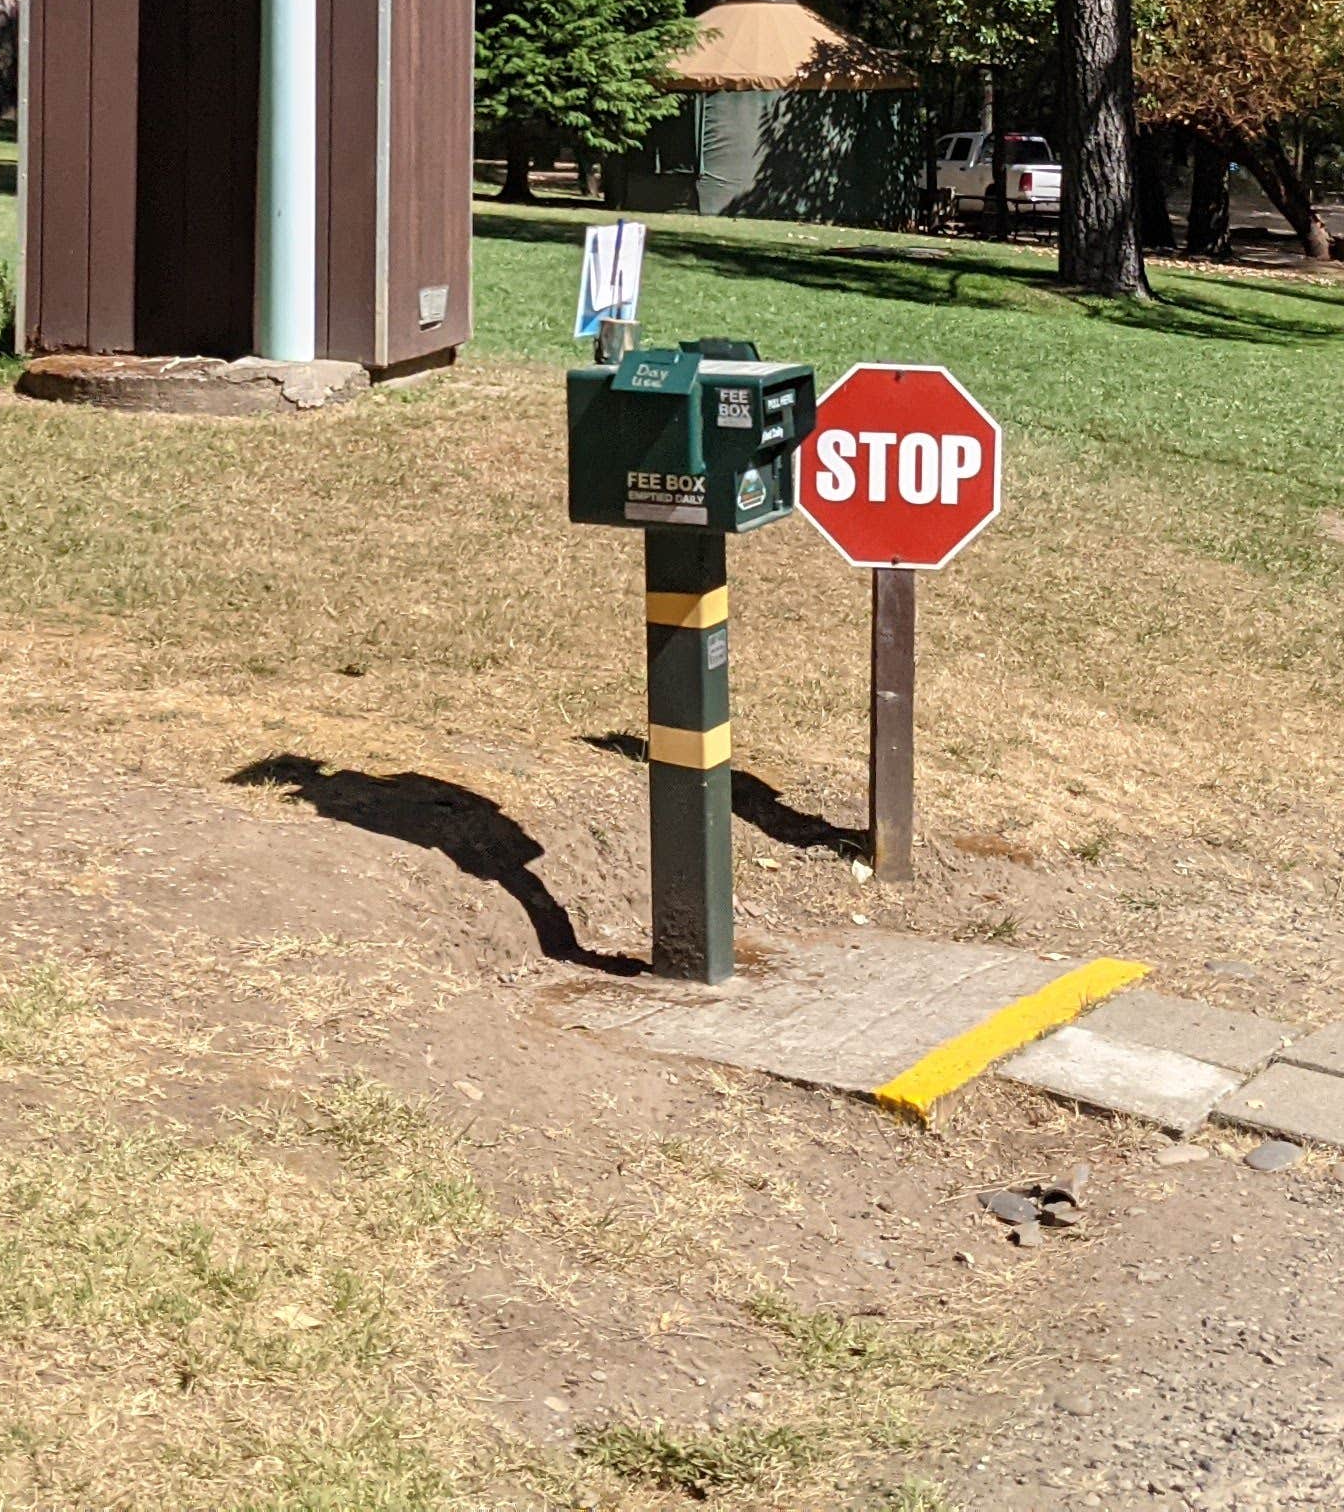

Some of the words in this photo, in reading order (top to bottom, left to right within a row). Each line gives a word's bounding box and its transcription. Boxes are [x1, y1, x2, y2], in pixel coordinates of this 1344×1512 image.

[636, 364, 669, 381] Day
[720, 389, 748, 403] FEE
[718, 404, 750, 417] BOX
[816, 429, 982, 505] STOP
[627, 472, 662, 490] FEE
[665, 474, 705, 493] BOX
[628, 490, 673, 503] EMPTIED
[675, 494, 705, 505] DAILY
